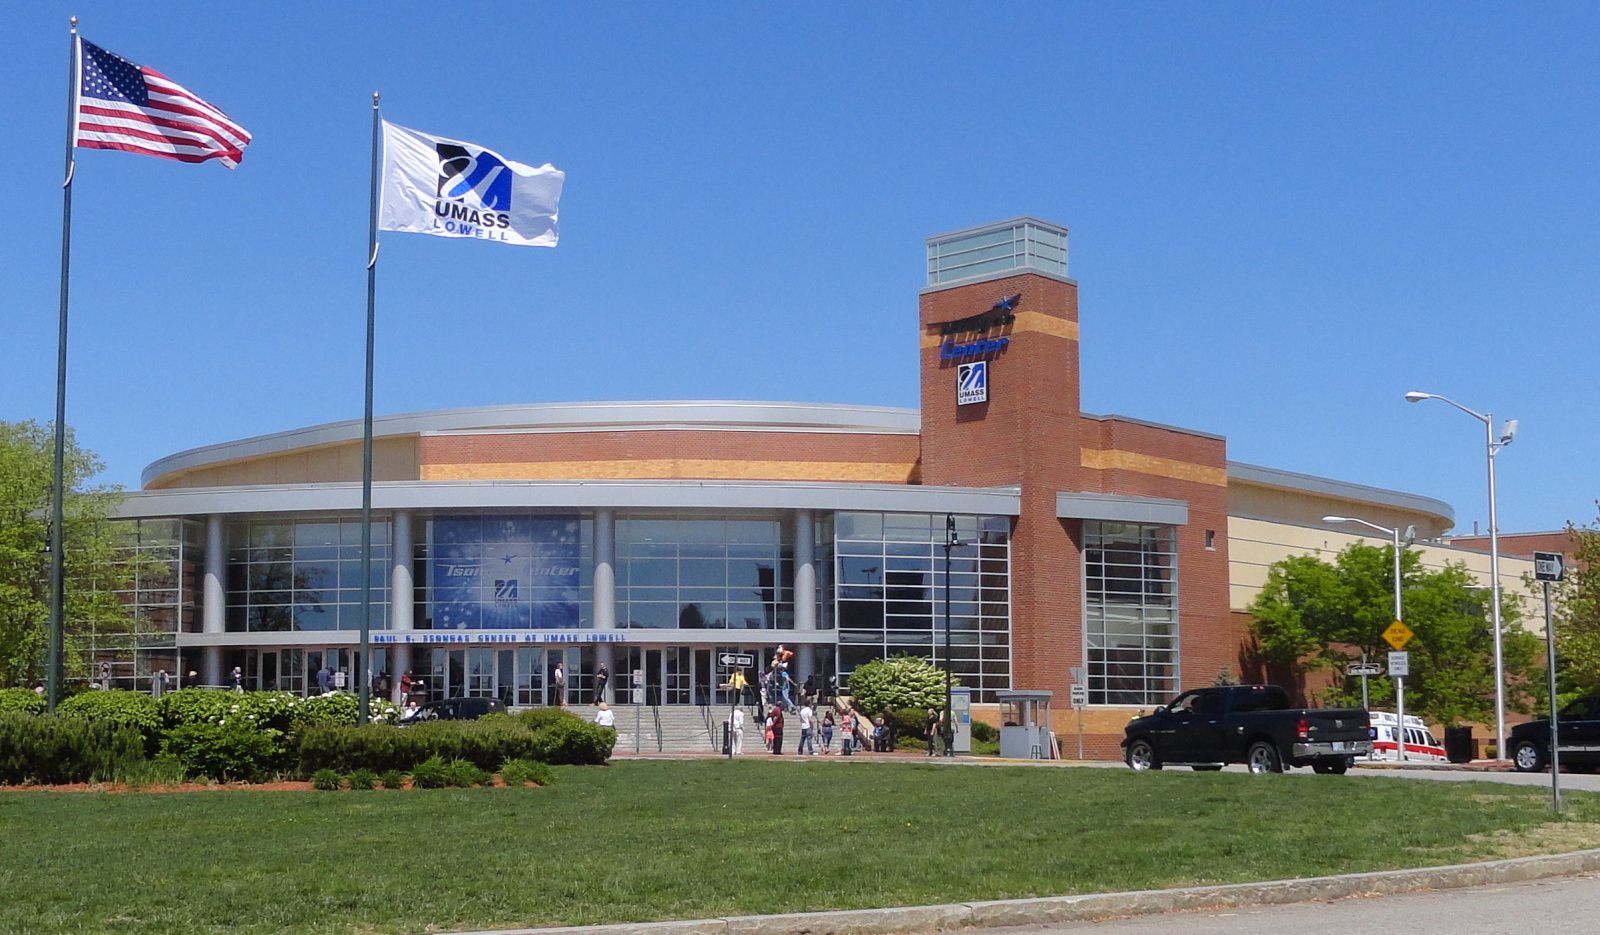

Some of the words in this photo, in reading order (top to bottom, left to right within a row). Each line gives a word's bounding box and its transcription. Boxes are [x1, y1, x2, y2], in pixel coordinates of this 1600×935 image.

[435, 201, 511, 229] UMASS
[433, 219, 508, 240] LOWELL
[940, 338, 1009, 361] Center
[959, 389, 985, 399] UMASS
[374, 634, 397, 642] PAUL
[423, 634, 470, 642] TSONGAS
[478, 634, 517, 642] CENTER
[525, 634, 537, 642] AT
[544, 634, 578, 642] UMASS
[586, 634, 626, 642] LOWELL
